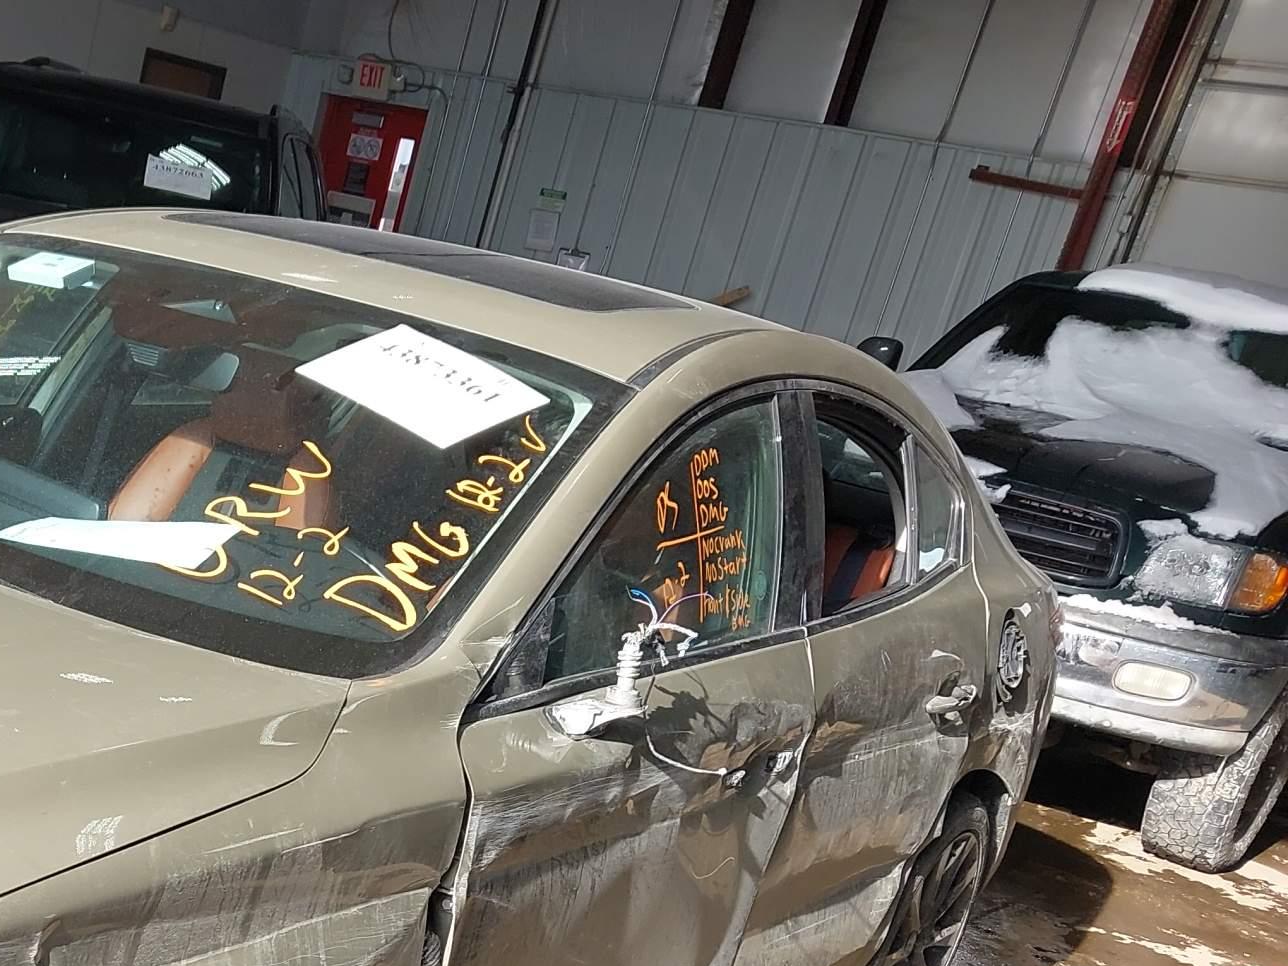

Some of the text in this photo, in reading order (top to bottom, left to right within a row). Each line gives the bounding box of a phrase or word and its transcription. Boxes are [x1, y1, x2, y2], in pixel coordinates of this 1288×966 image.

[359, 63, 385, 88] EXIT
[699, 500, 729, 528] DMG
[237, 526, 350, 606] 12-2
